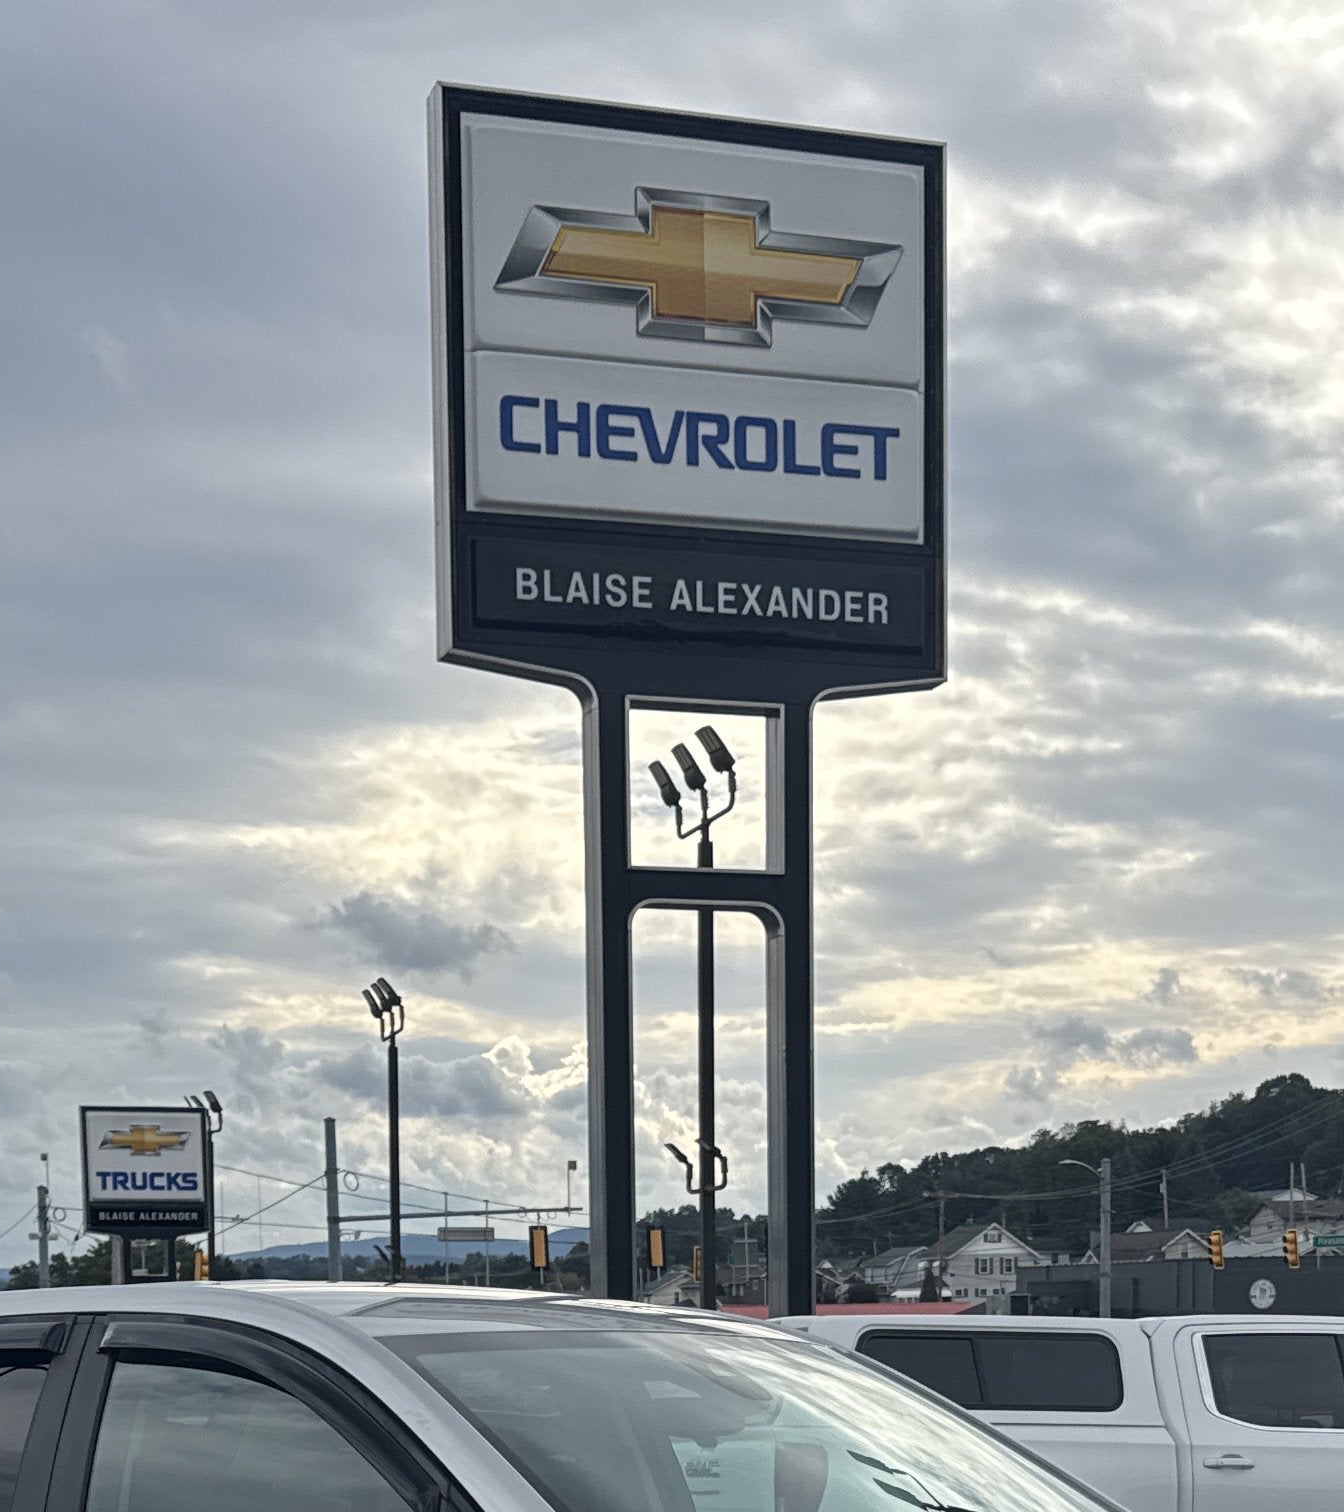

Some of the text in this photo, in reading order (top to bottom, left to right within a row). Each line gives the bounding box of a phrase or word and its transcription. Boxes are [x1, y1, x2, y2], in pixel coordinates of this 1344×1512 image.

[499, 395, 900, 481] CHEVROLET
[515, 567, 890, 626] BLAISE ALEXANDER
[96, 1171, 198, 1191] TRUCKS
[98, 1211, 199, 1221] BLAISE ALEXANDER
